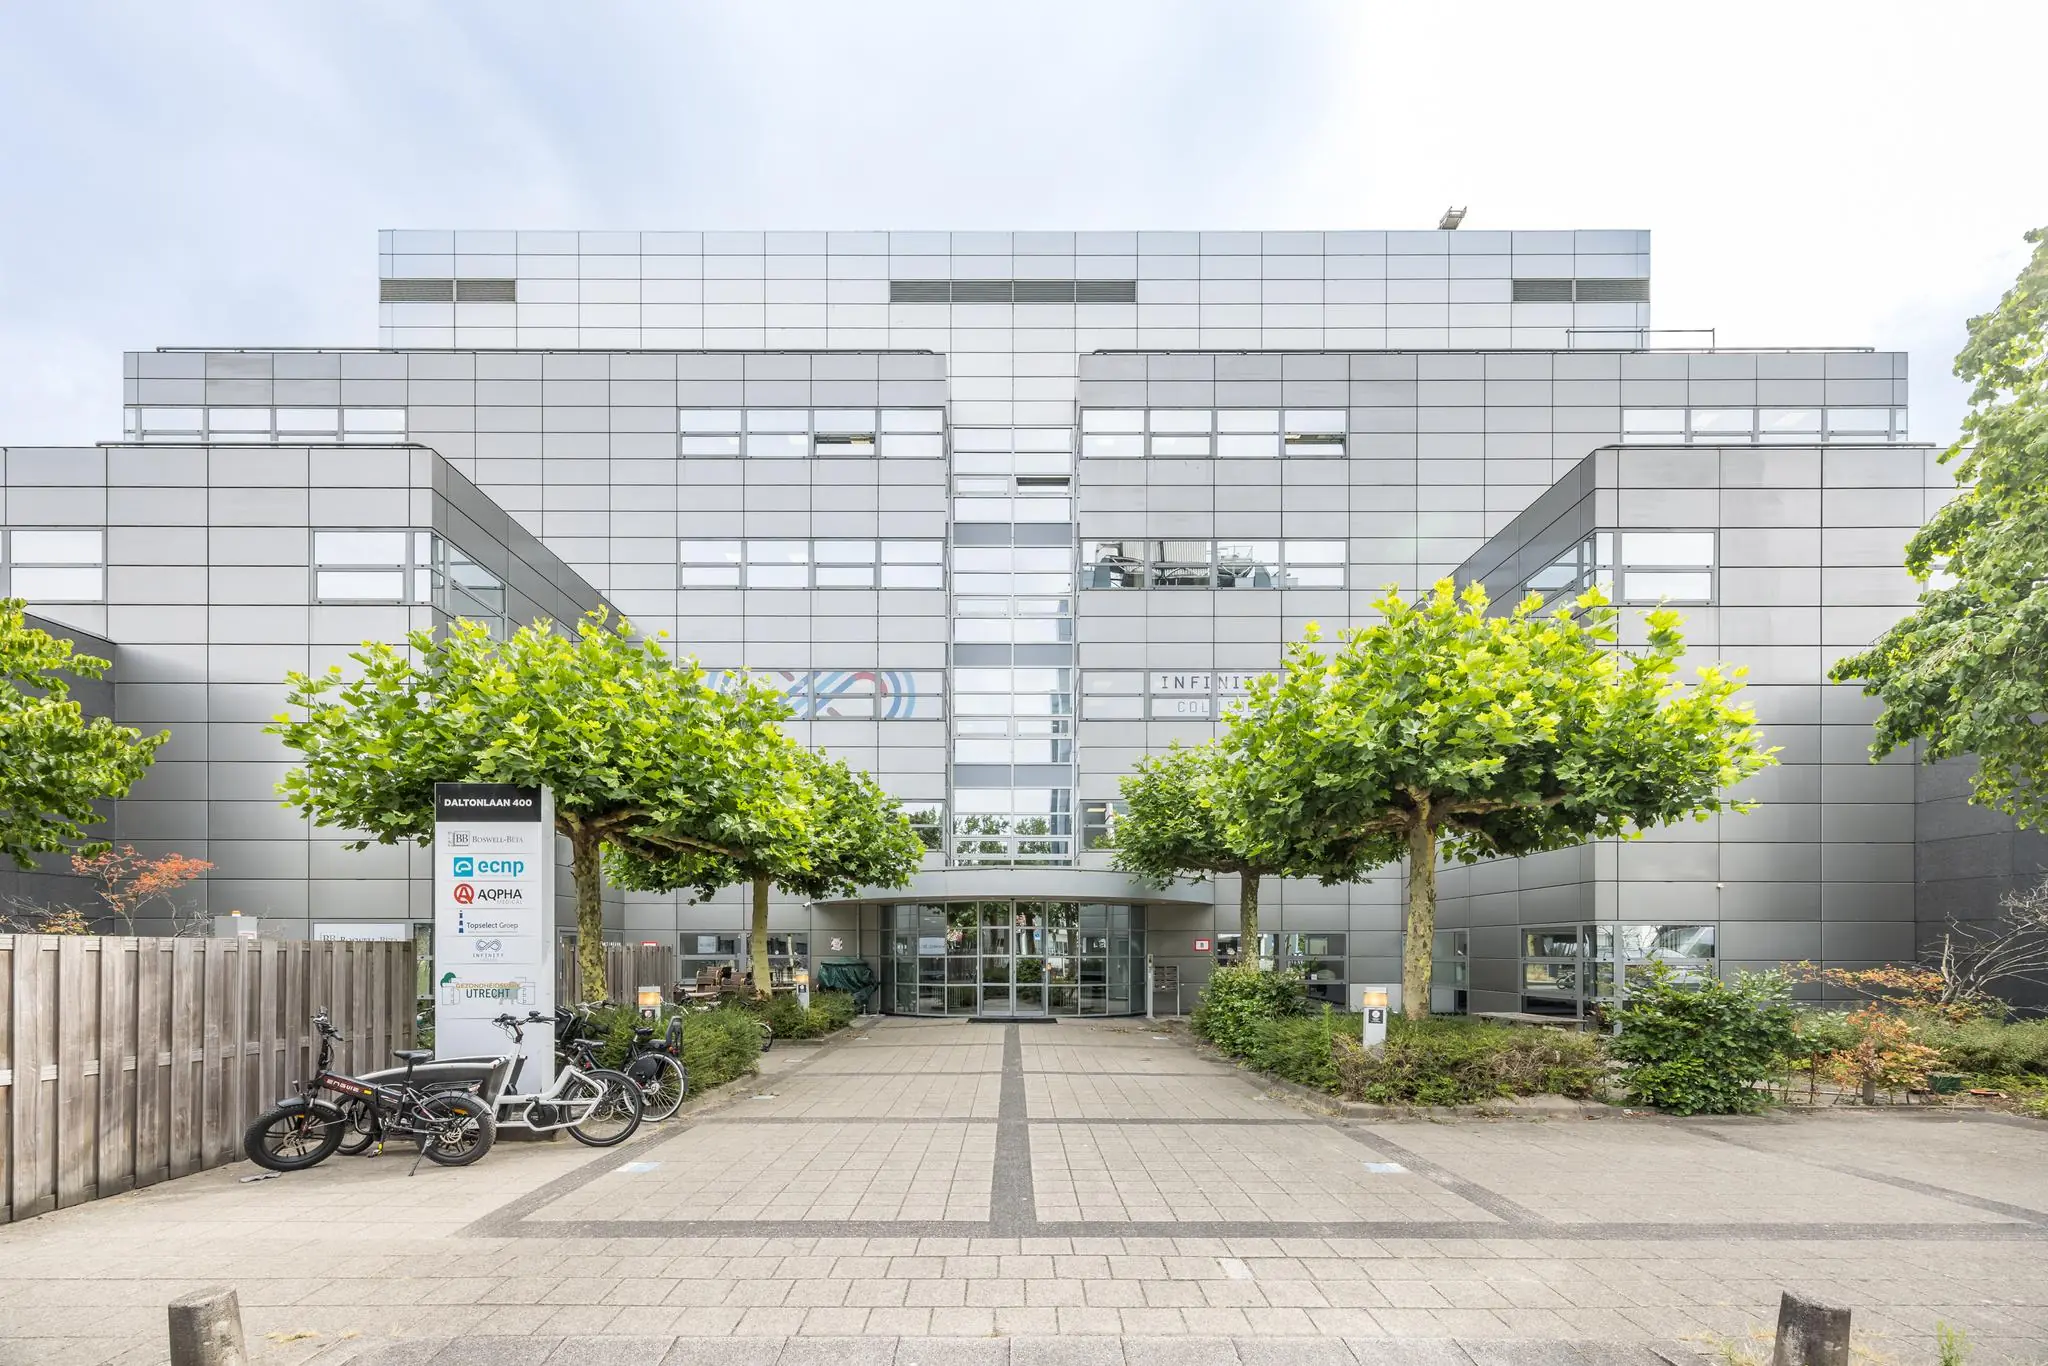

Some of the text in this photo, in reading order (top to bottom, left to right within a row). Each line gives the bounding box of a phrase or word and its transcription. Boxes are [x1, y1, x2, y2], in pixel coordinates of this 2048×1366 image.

[1161, 676, 1254, 689] INFINIT
[444, 799, 533, 807] DALTONLAAN 400
[478, 860, 524, 877] ecnp
[478, 888, 523, 901] AQPHA
[467, 922, 519, 930] Topselect Groep
[466, 989, 511, 999] UTRECHT
